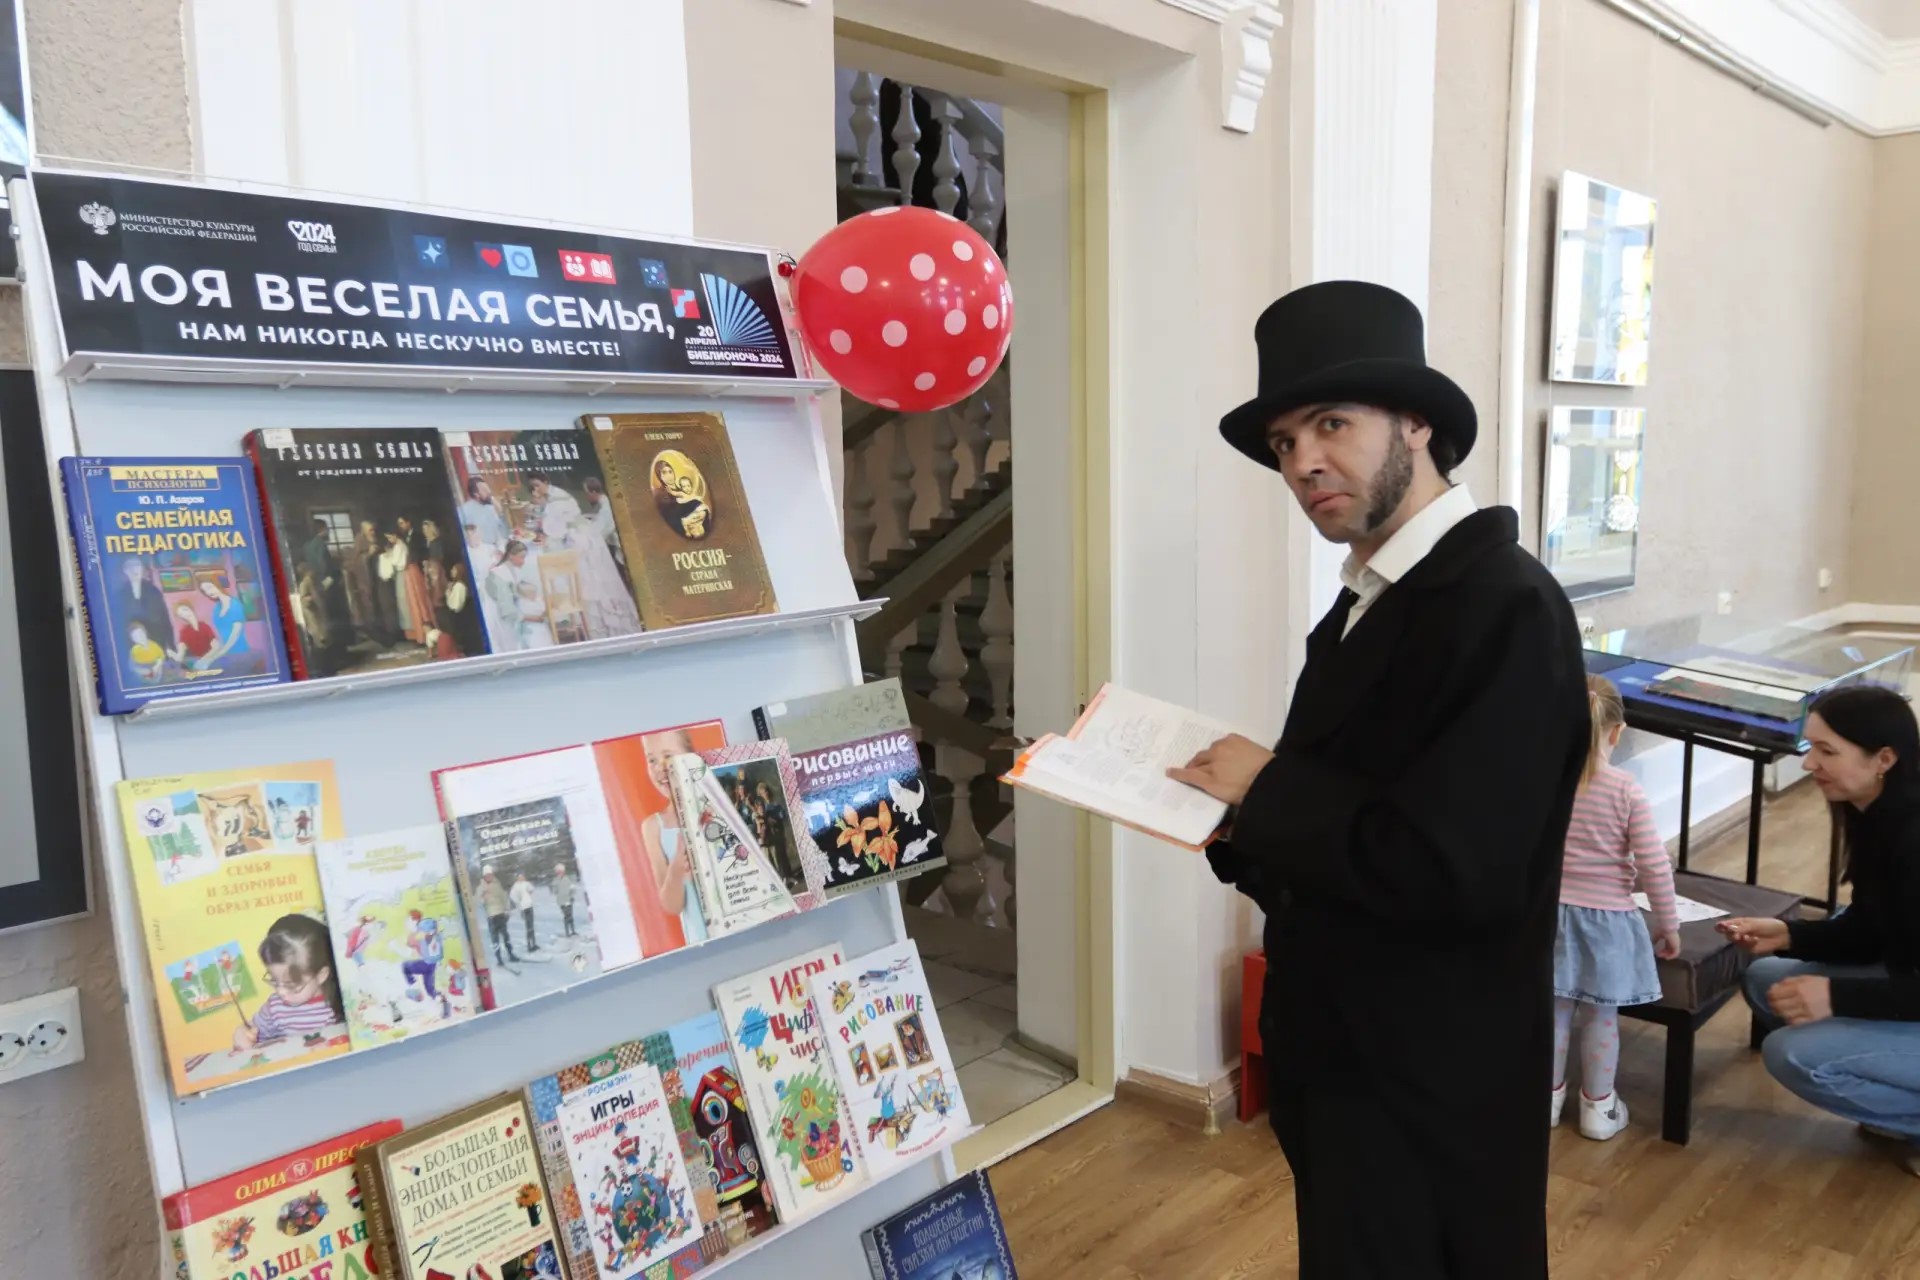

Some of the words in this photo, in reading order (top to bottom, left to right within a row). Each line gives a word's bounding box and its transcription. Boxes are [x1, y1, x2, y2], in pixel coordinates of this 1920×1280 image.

[119, 212, 204, 229] МИНИСТЕРСТВО
[206, 221, 256, 234] КУЛЬТУРЫ
[121, 222, 196, 238] РОССИЙСКОЙ
[197, 230, 258, 243] ФЕДЕРАЦИИ
[298, 220, 337, 245] 2024
[297, 241, 313, 253] ГОД
[75, 259, 233, 309] МОЯ
[254, 272, 509, 327] ВЕСЕЛАЯ
[525, 291, 676, 341] СЕМЬЯ,
[178, 320, 247, 344] НАМ
[257, 324, 389, 350] НИКОГДА
[396, 331, 524, 355] НЕСКУЧНО
[531, 338, 622, 357] ВМЕСТЕ!
[684, 336, 718, 346] АПРЕЛЯ
[697, 325, 715, 338] 20
[686, 350, 760, 363] БИБЛИОНОЧЬ
[759, 354, 784, 364] 2024
[125, 469, 206, 480] МАСТЕРА
[127, 479, 208, 490] ПСИХОЛОГИИ
[138, 495, 154, 505] Ю.
[155, 495, 168, 505] П.
[115, 506, 234, 530] СЕМЕЙНАЯ
[105, 531, 247, 556] ПЕДАГОГИКА
[811, 767, 860, 787] первые
[863, 759, 897, 774] шаги
[225, 860, 272, 878] СЕМЬЯ
[206, 886, 217, 898] И
[222, 872, 298, 898] ЗДОРОВЫЙ
[205, 901, 251, 917] ОБРАЗ
[254, 890, 304, 908] ЖИЗНИ
[839, 992, 924, 1044] РИСОВАНИЕ
[590, 1089, 635, 1122] ИГРЫ
[572, 1098, 660, 1145] ЭНЦИКЛОПЕДИЯ
[423, 1125, 500, 1173] БОЛЬШАЯ
[398, 1134, 531, 1207] ЭНЦИКЛОПЕДИЯ
[235, 1170, 287, 1201] ОЛМА
[412, 1194, 460, 1227] ДОМА
[461, 1183, 474, 1201] И
[476, 1157, 529, 1194] СЕМЬИ
[912, 1206, 965, 1249] ВОЛШЕБНЫЕ
[901, 1243, 937, 1275] СКАЗКИ
[935, 1212, 986, 1254] ИНГУШЕТИИ
